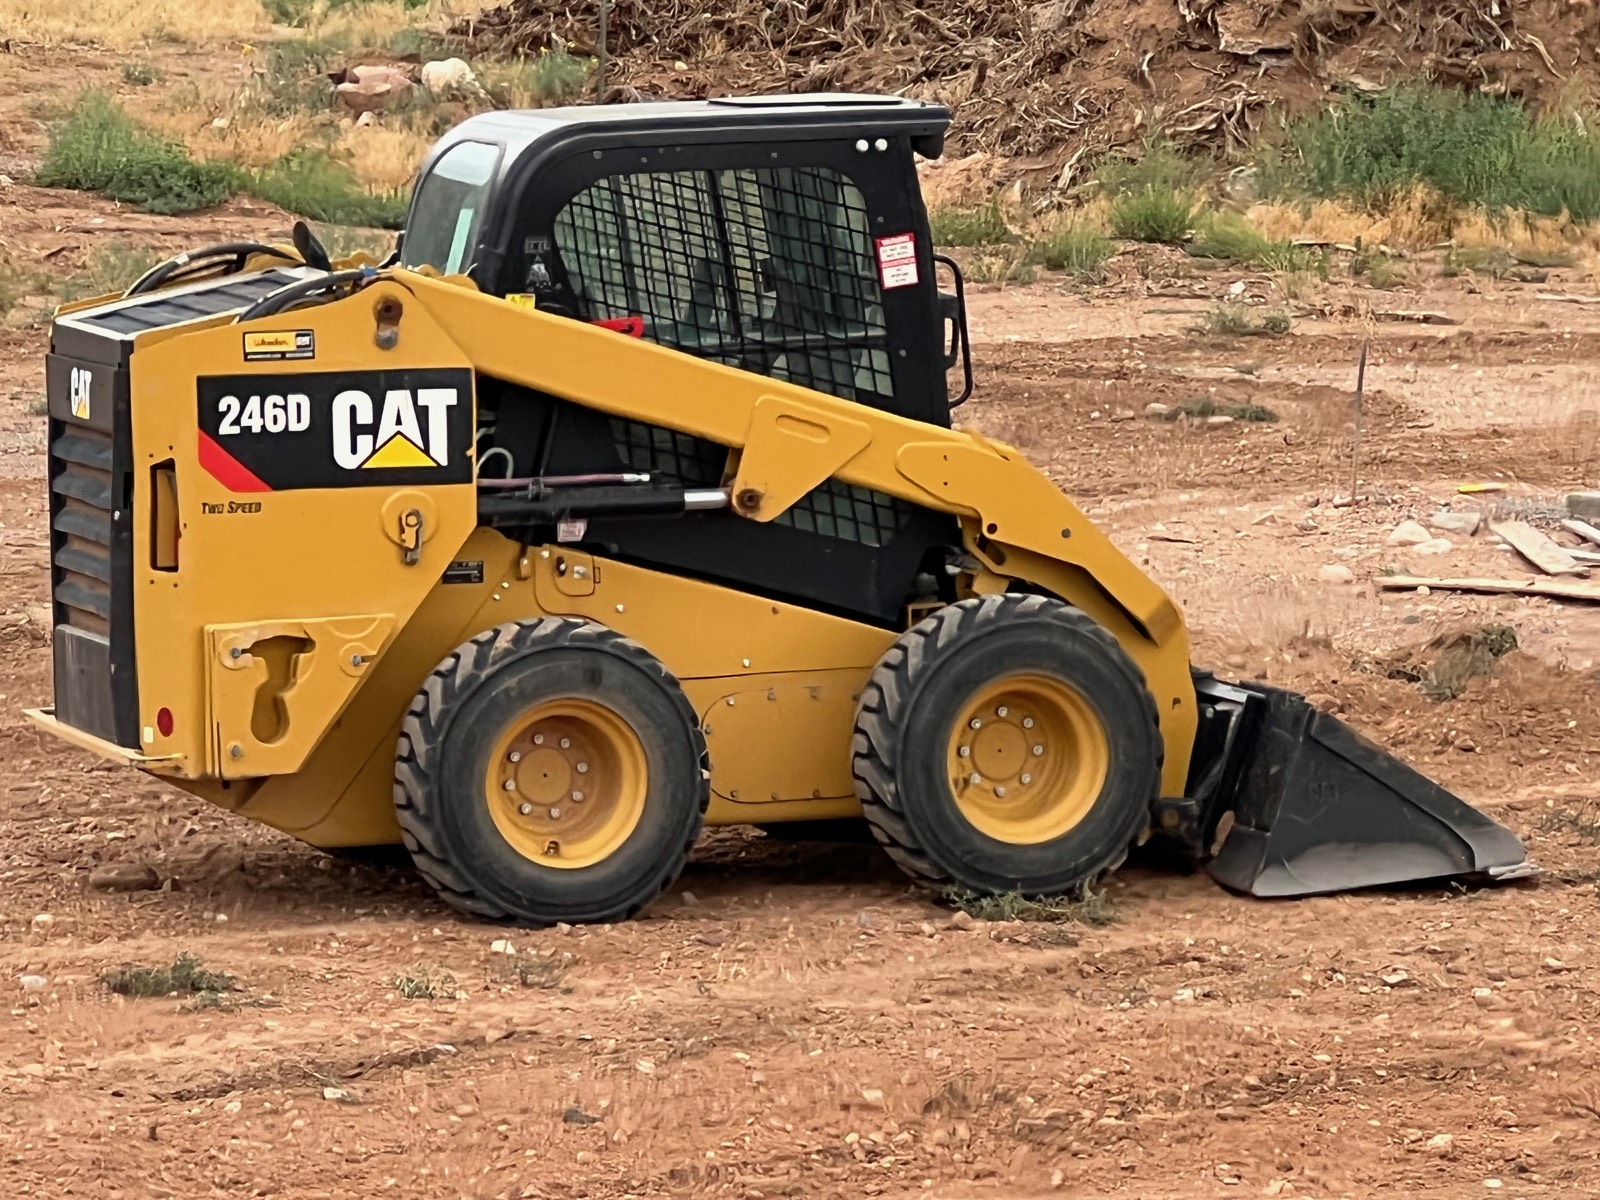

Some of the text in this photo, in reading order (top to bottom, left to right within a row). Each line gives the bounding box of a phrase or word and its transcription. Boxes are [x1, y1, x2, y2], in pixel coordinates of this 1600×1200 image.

[70, 366, 92, 420] CAT
[217, 388, 458, 470] 246D CAT
